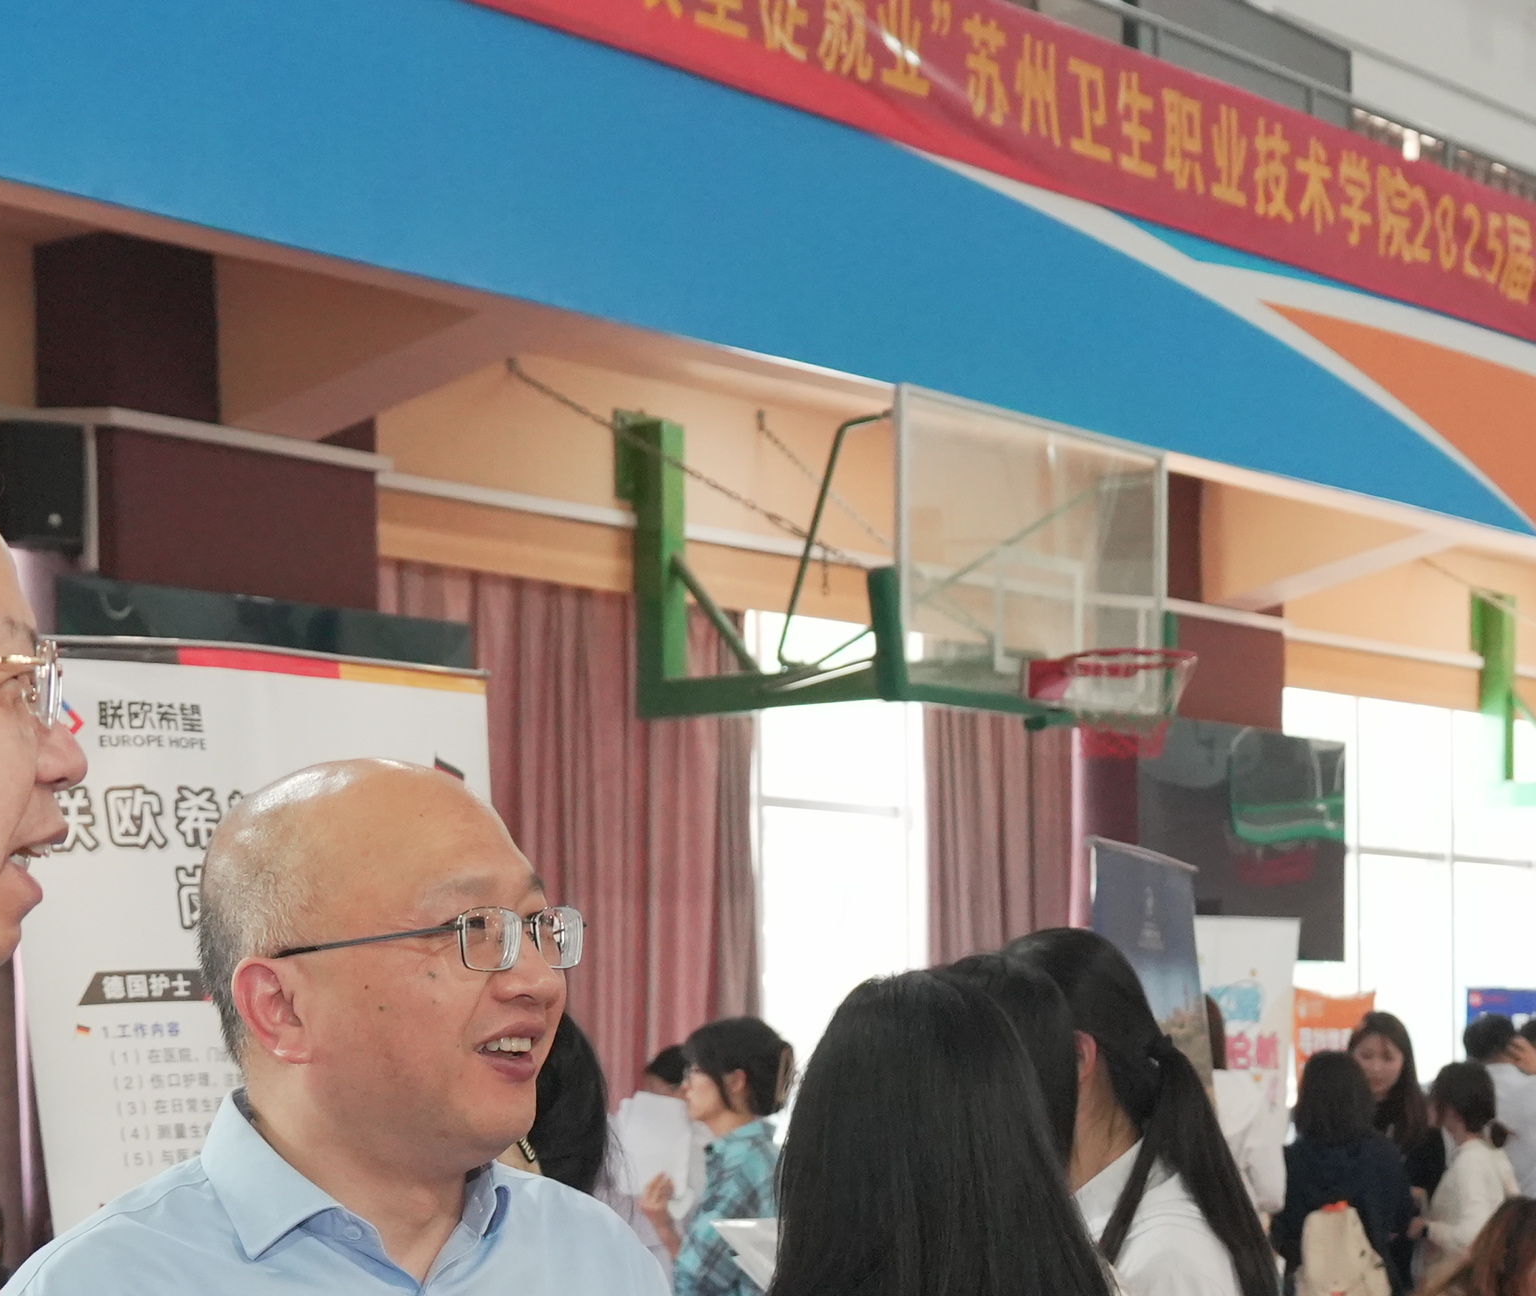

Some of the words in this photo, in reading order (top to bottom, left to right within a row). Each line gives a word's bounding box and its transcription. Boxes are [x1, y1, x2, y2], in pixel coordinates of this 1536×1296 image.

[98, 699, 205, 733] 联欧希望
[99, 735, 164, 748] EUROPE
[169, 737, 207, 751] HOPE
[52, 784, 245, 852] 联欧希
[101, 974, 192, 999] 德国护士
